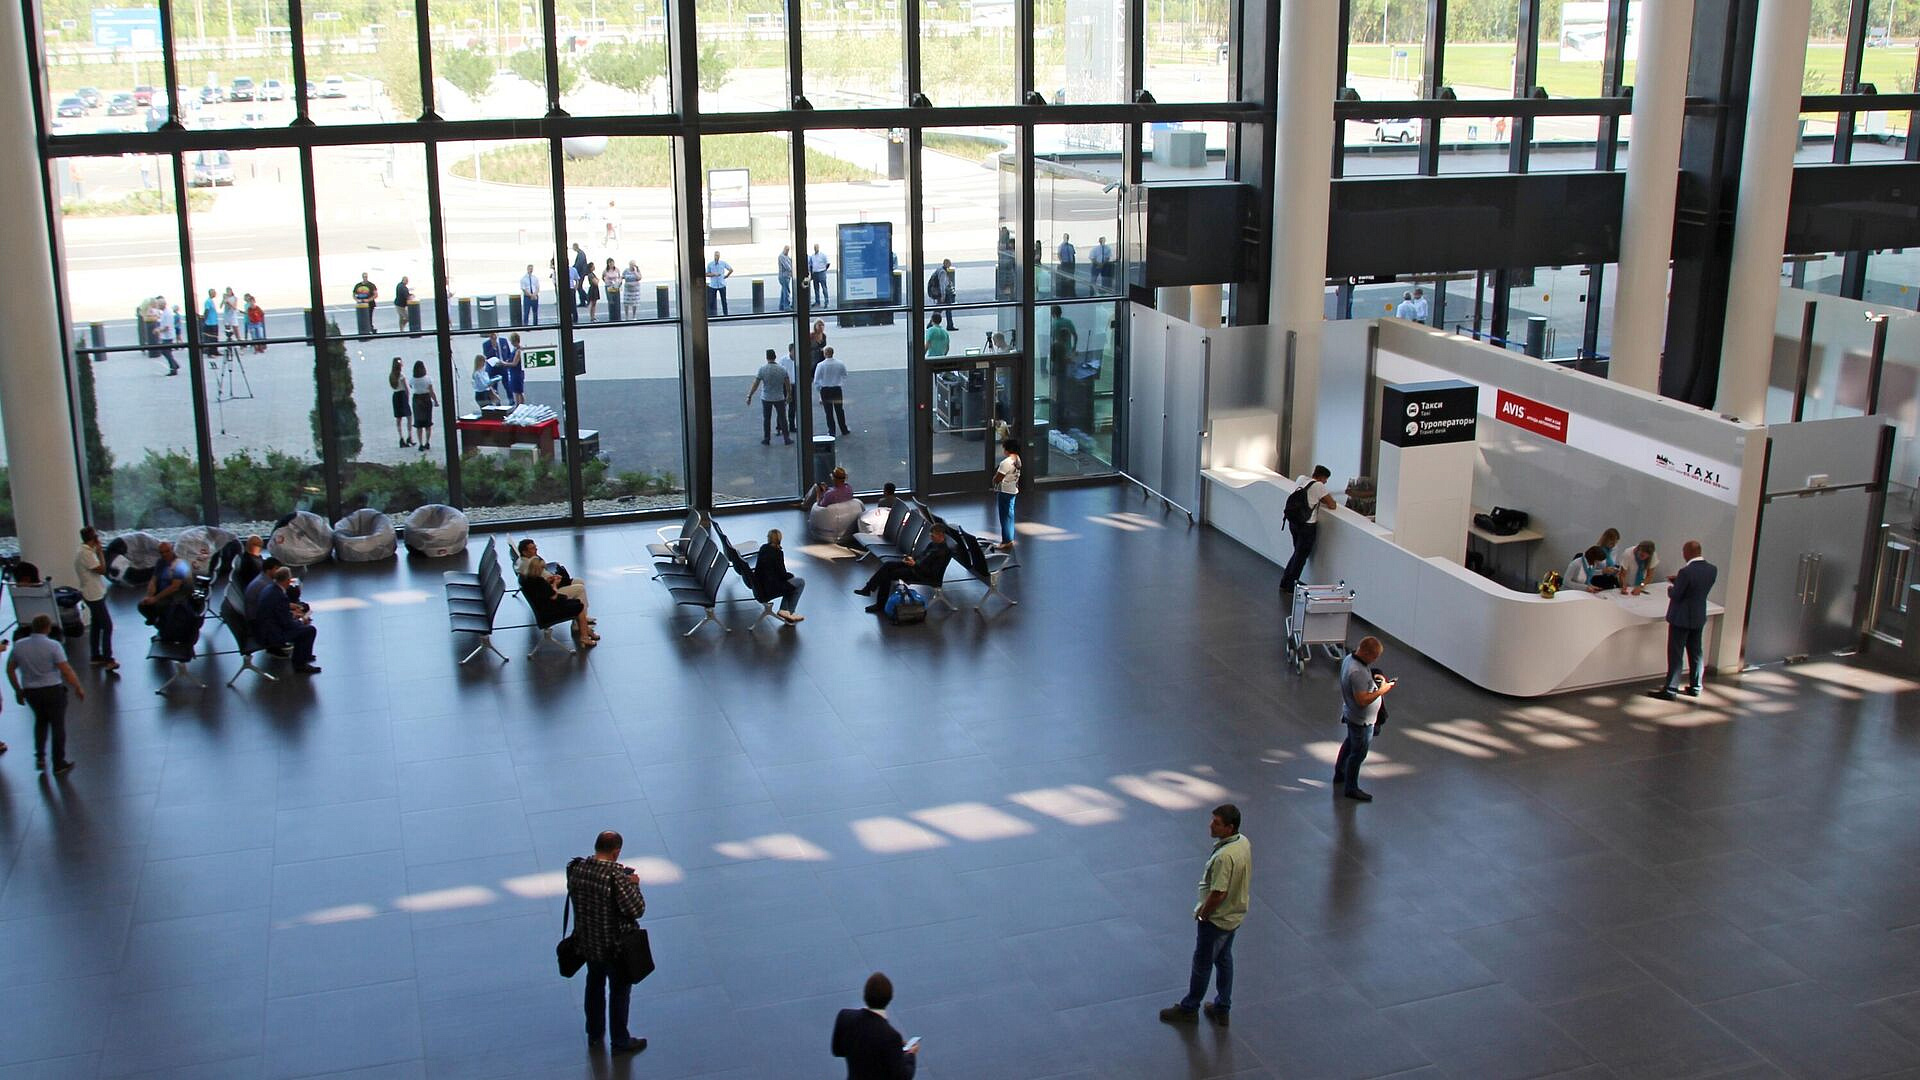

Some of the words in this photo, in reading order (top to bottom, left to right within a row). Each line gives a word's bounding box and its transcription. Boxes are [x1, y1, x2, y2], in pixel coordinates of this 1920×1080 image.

[1421, 402, 1443, 410] Такси
[1502, 401, 1525, 418] AVIS
[1420, 418, 1475, 430] Туроператоры
[1685, 463, 1720, 483] TAXI
